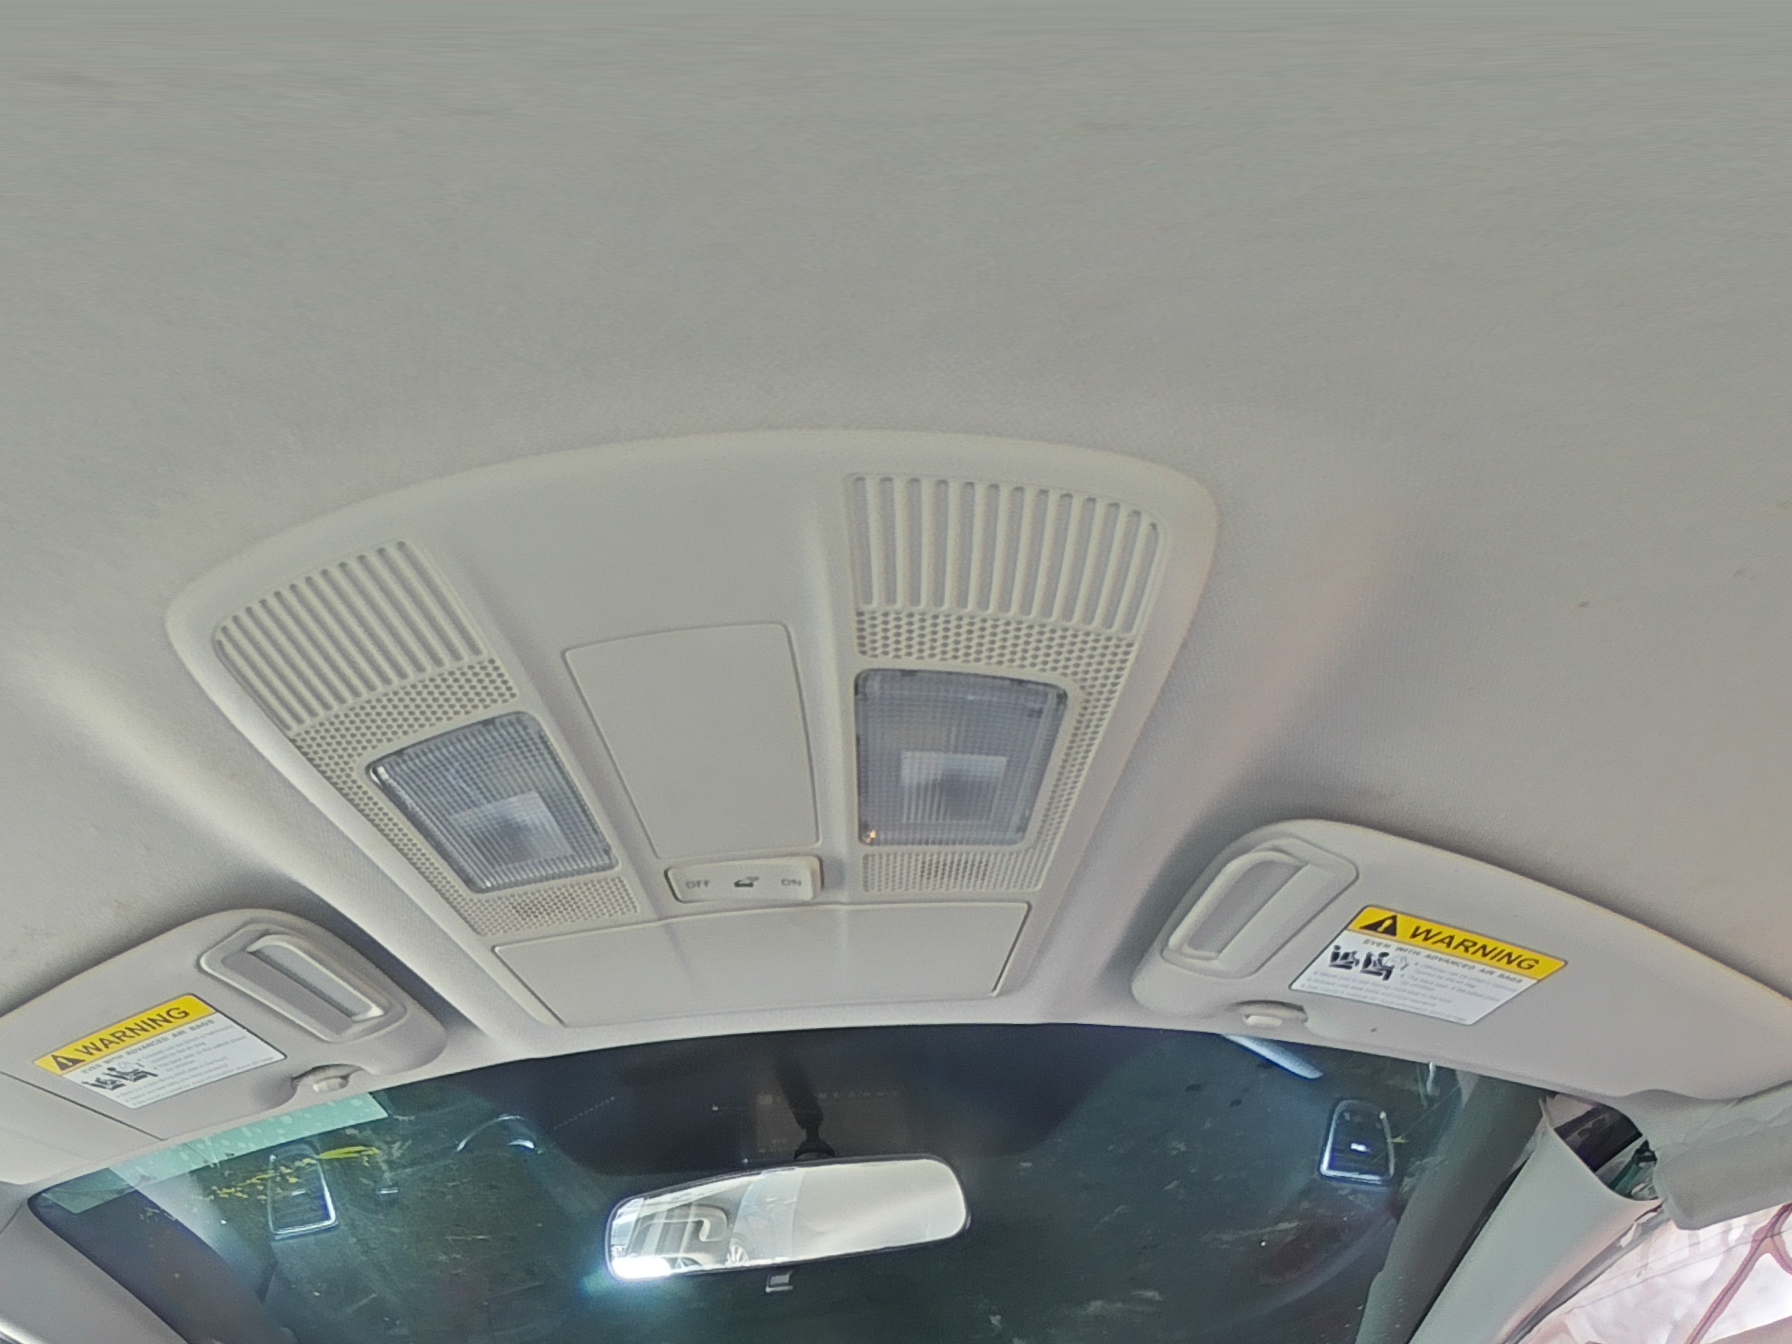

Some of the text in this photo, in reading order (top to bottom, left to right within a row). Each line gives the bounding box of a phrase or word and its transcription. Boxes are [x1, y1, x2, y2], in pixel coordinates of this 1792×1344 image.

[685, 879, 710, 889] OFF
[780, 878, 802, 887] ON
[1362, 938, 1391, 949] EVEN
[1424, 953, 1476, 970] ADVANCED
[1408, 924, 1540, 972] WARNING
[74, 1006, 191, 1057] WARNING
[125, 1036, 170, 1056] ADVANCED
